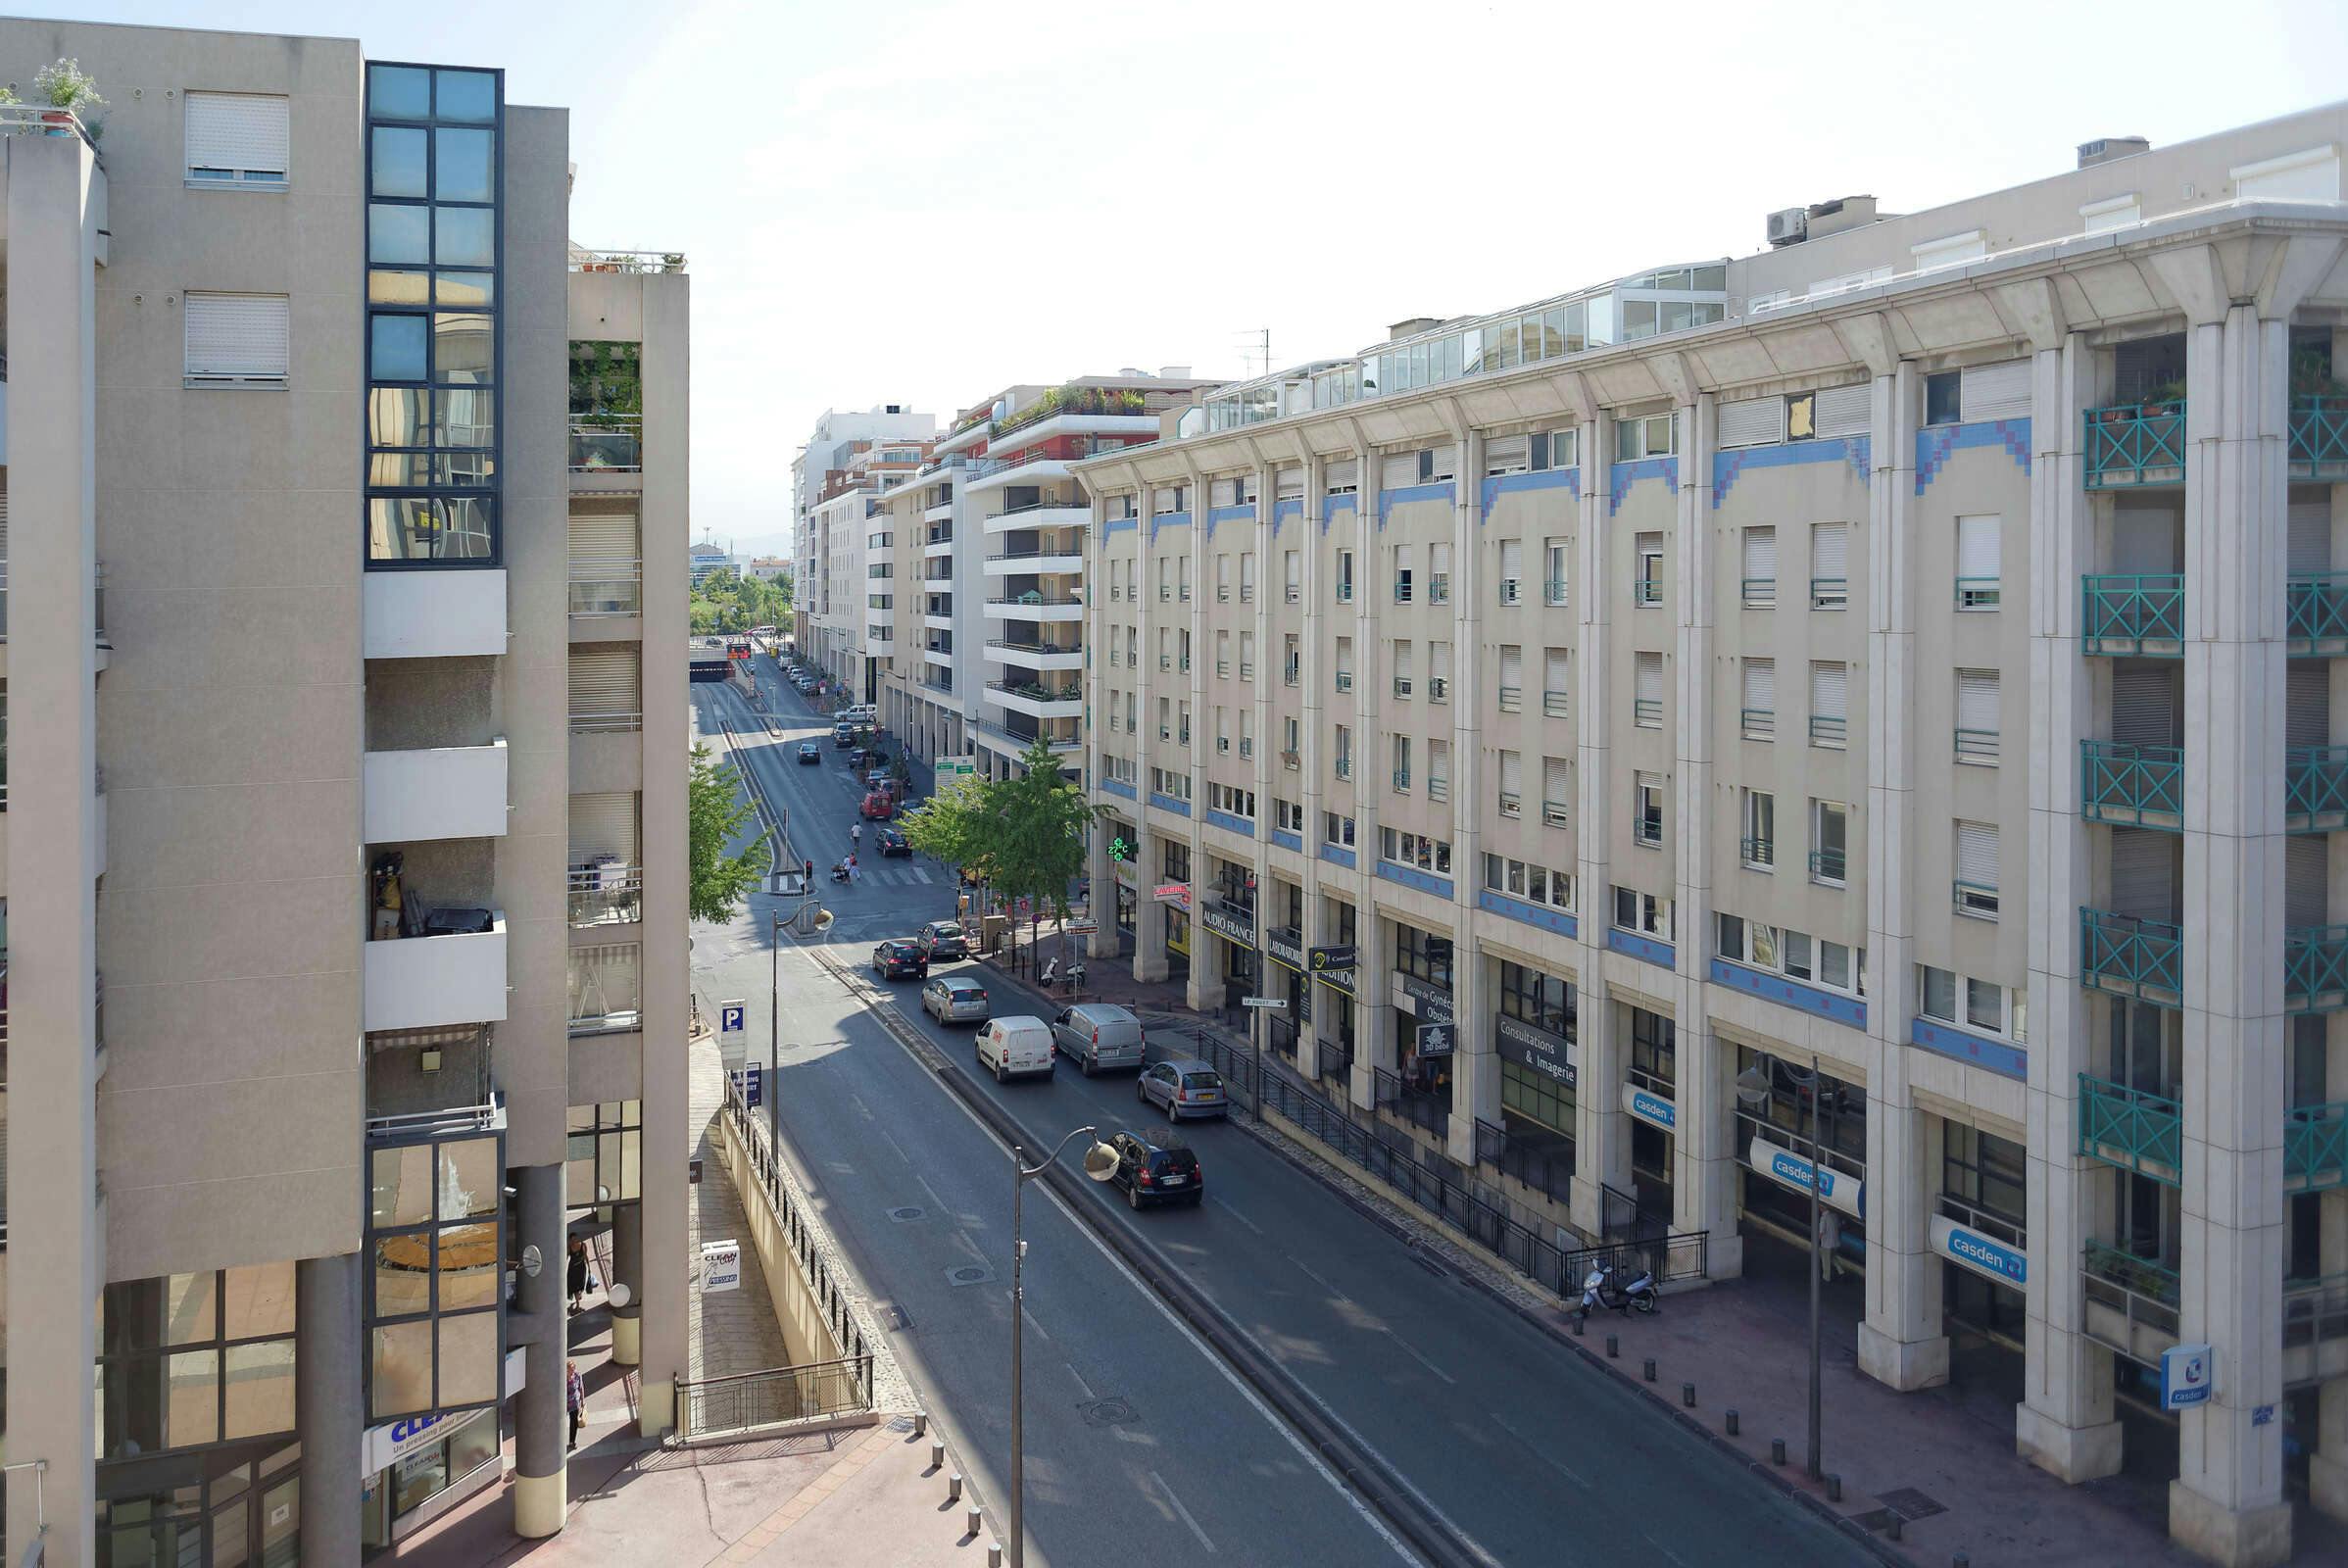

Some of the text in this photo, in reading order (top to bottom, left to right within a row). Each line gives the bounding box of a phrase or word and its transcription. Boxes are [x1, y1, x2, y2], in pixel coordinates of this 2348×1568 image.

[1203, 909, 1226, 930] AUDIO
[1227, 919, 1254, 942] FRANCE
[726, 1009, 740, 1026] P
[1500, 1021, 1555, 1054] Consultations
[1525, 1050, 1575, 1082] & Imagerie
[1636, 1098, 1667, 1120] casden
[1953, 1238, 2003, 1269] casden
[2175, 1390, 2203, 1401] casden
[406, 1428, 438, 1449] pressing
